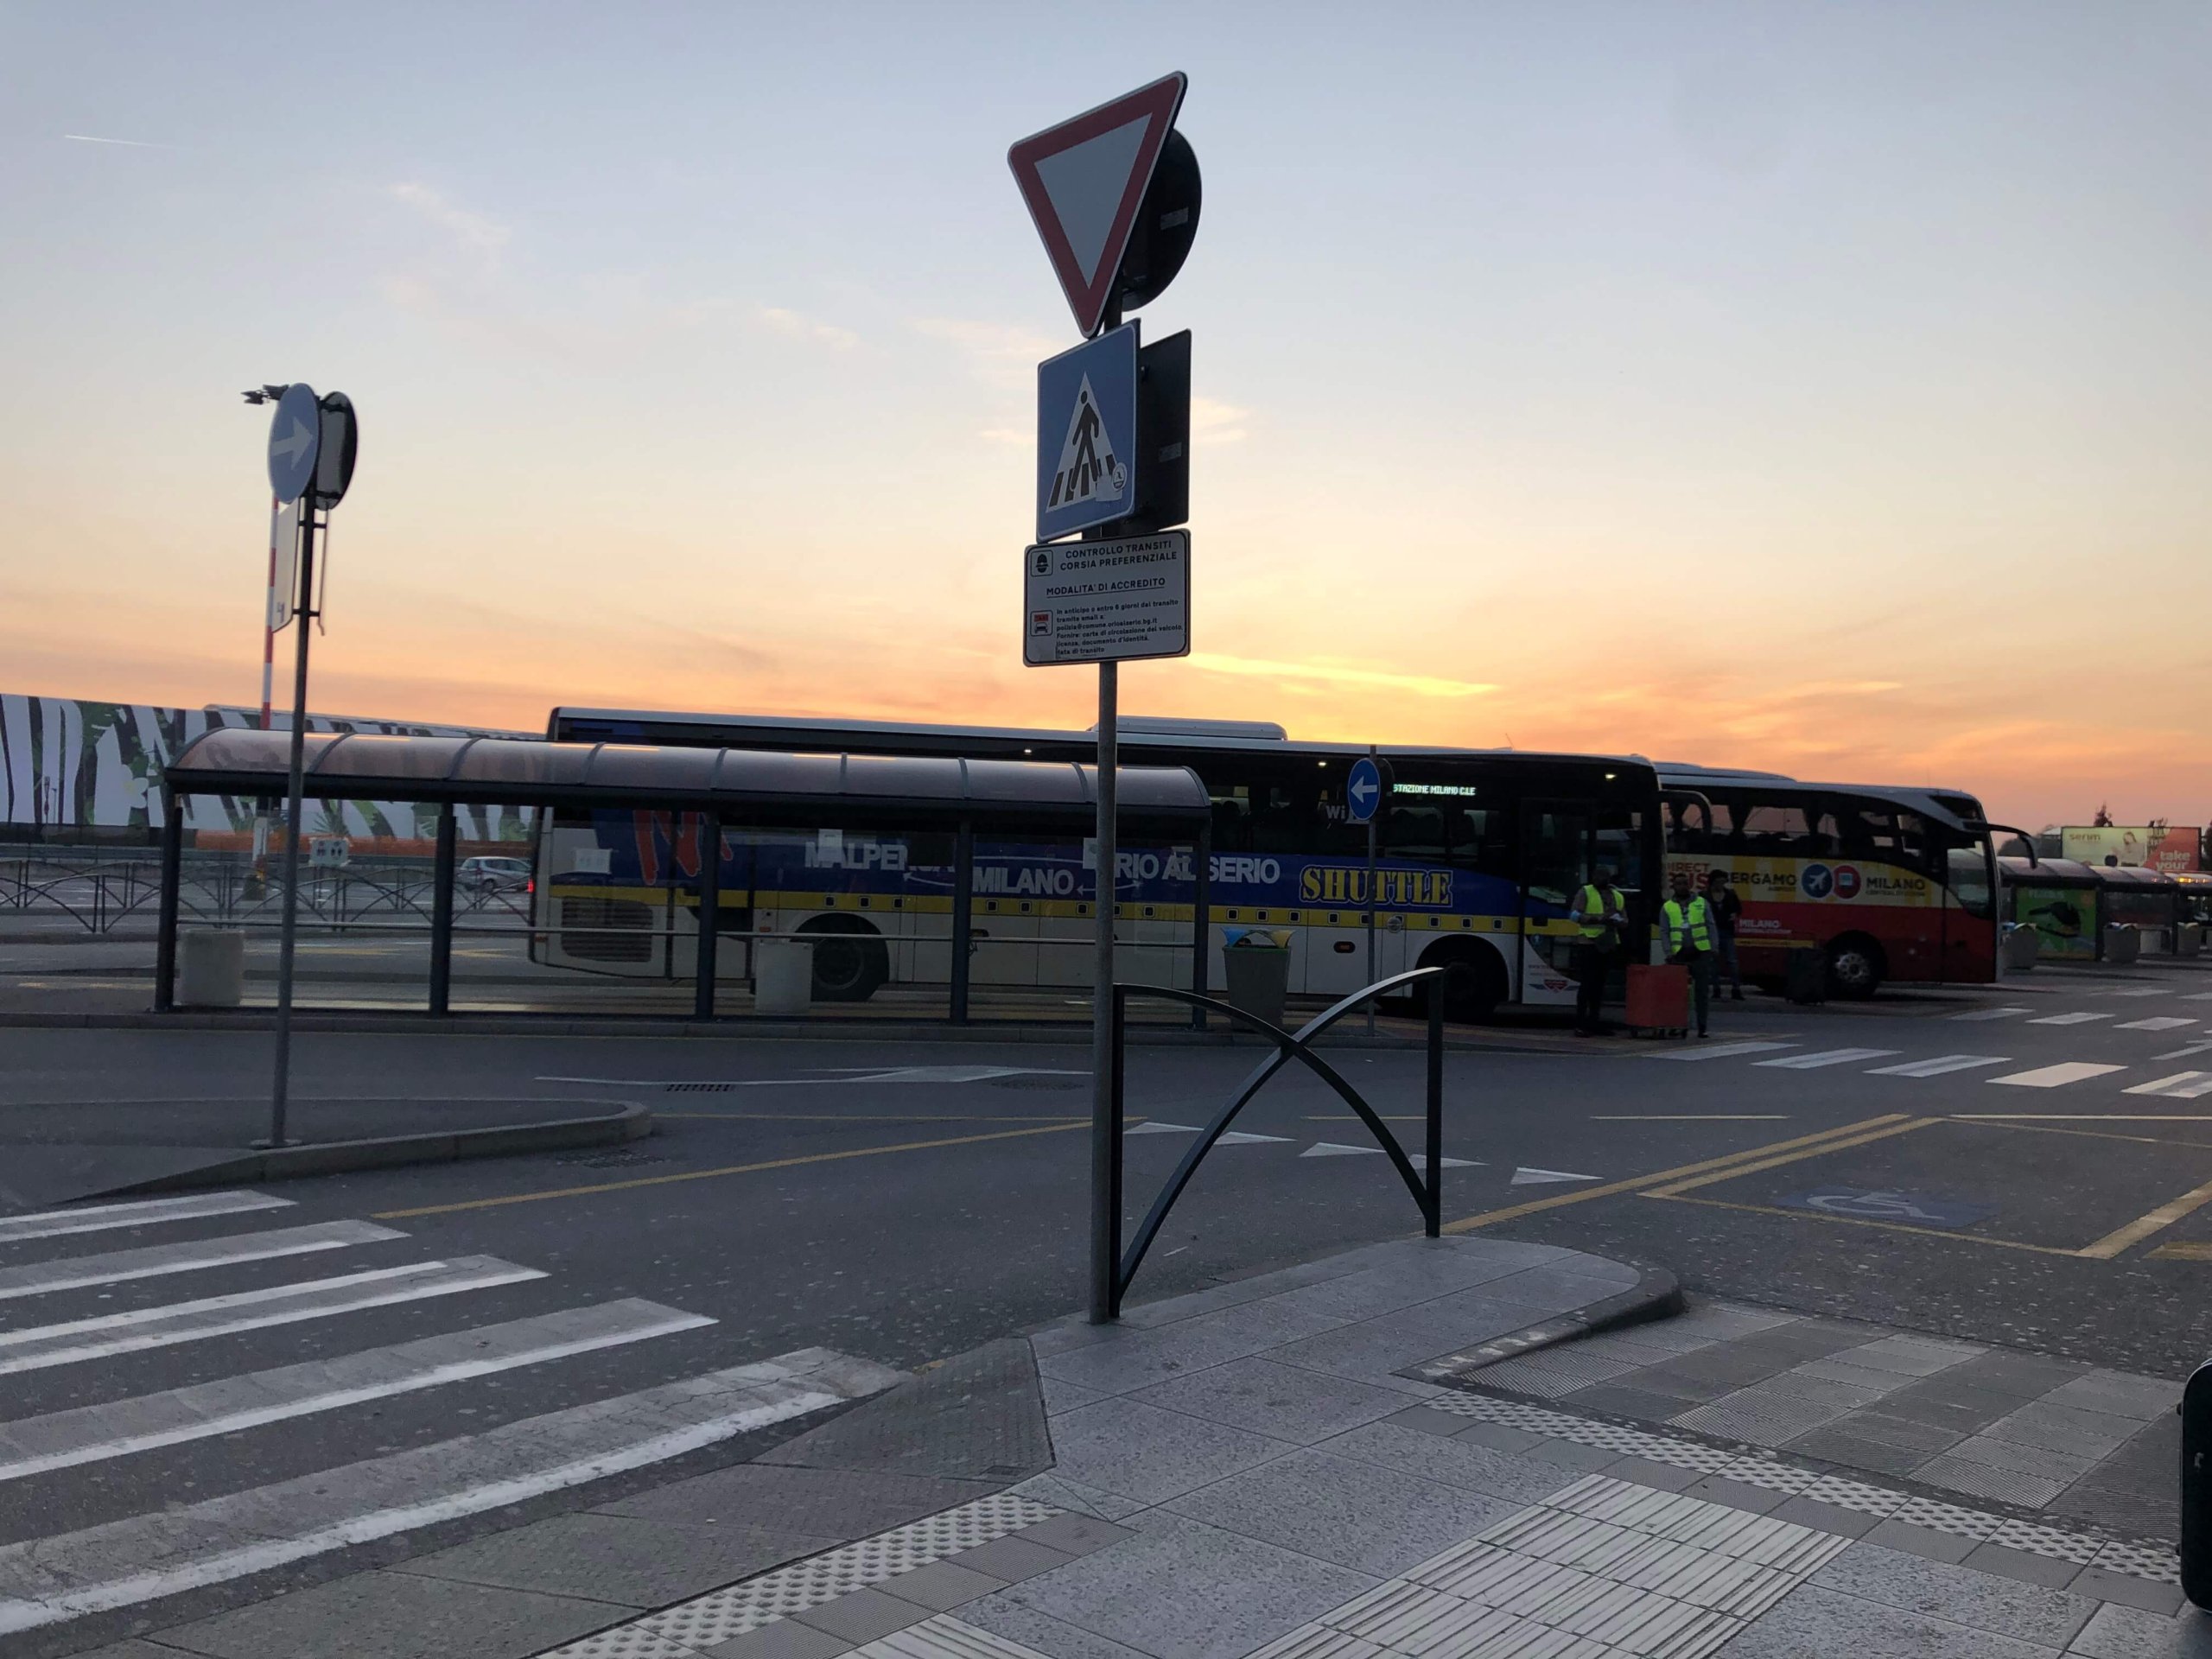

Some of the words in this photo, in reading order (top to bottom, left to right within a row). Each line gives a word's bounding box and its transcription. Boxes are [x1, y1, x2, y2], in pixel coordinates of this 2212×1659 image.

[1065, 545, 1123, 559] CONTROLLO
[1126, 540, 1172, 552] TRANSITI
[1060, 560, 1096, 571] CORSIA
[1099, 551, 1177, 567] PREFERENZIALE
[1046, 584, 1096, 596] MODALITA'
[1098, 583, 1108, 592] DI
[1110, 577, 1166, 590] ACCREDITO
[1121, 602, 1139, 611] giorni
[1108, 626, 1145, 636] circolazione
[1393, 784, 1429, 794] STAZIONE
[1430, 785, 1459, 795] MILANO
[2160, 850, 2190, 861] take
[1115, 852, 1160, 880] RIO
[1161, 855, 1197, 880] AL
[1210, 856, 1281, 884] SERIO
[2156, 861, 2189, 871] your
[972, 867, 1074, 895] MILANO
[1730, 872, 1796, 886] ERGAMO
[1866, 877, 1925, 890] MILANO
[1302, 867, 1453, 905] SHUTTLE
[1738, 918, 1780, 929] MILANO
